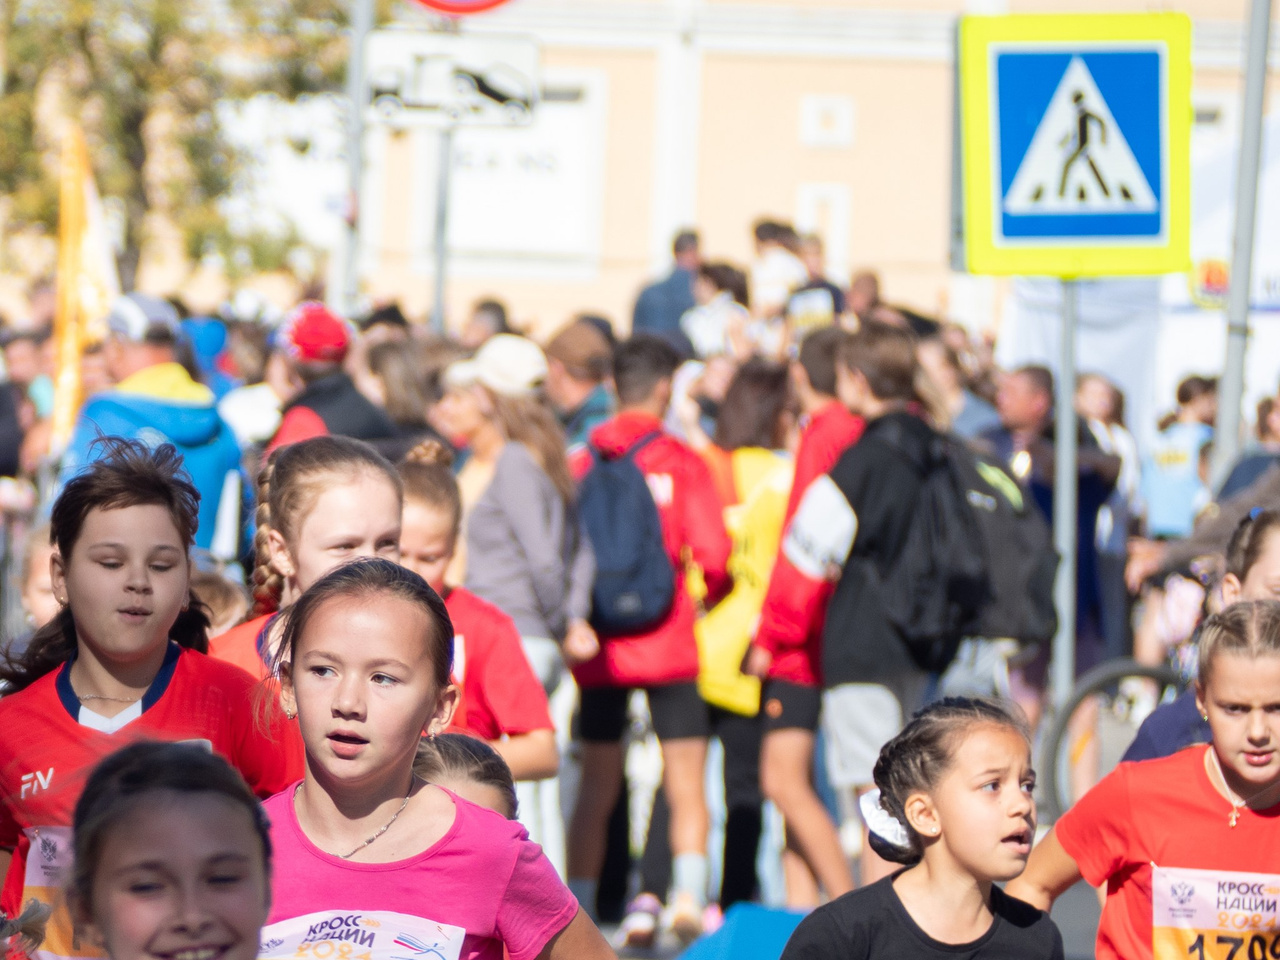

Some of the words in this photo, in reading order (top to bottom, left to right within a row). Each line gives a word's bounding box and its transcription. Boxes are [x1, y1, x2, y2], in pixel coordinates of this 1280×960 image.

[1218, 881, 1265, 896] КРОСС
[1216, 897, 1278, 913] НАЦИИ
[307, 915, 362, 936] КРОСС
[1217, 911, 1277, 929] 2024
